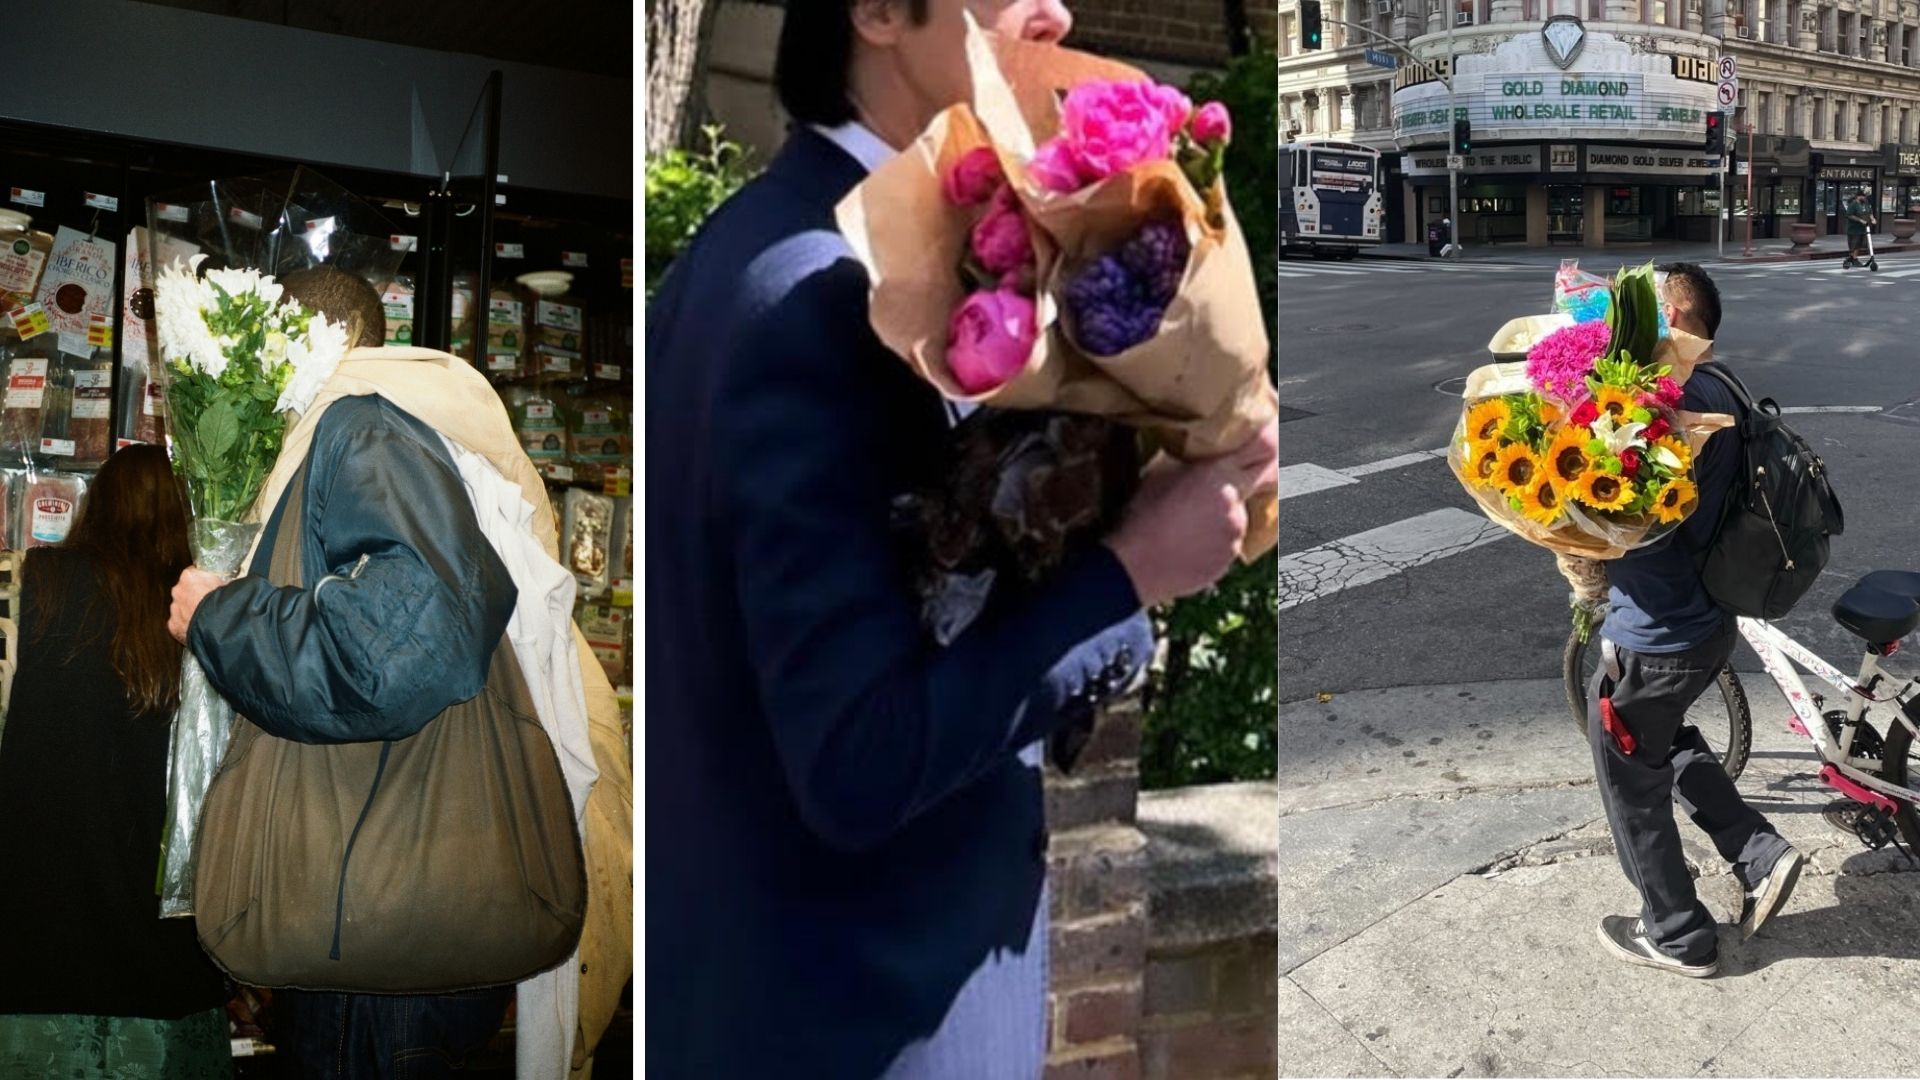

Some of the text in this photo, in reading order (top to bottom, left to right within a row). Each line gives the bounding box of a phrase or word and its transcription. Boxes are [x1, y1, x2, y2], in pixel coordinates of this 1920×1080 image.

[1502, 81, 1629, 96] GOLD DIAMOND
[1492, 104, 1638, 120] WHOLESALE RETAIL
[1464, 157, 1475, 166] TO
[1480, 156, 1495, 166] THE
[1501, 154, 1533, 166] PUBLIC
[1552, 150, 1576, 163] JTB
[1590, 154, 1629, 166] DIAMOND
[1633, 156, 1655, 167] GOLD
[1659, 157, 1684, 168] SILVER
[1820, 168, 1872, 179] ENTRANCE
